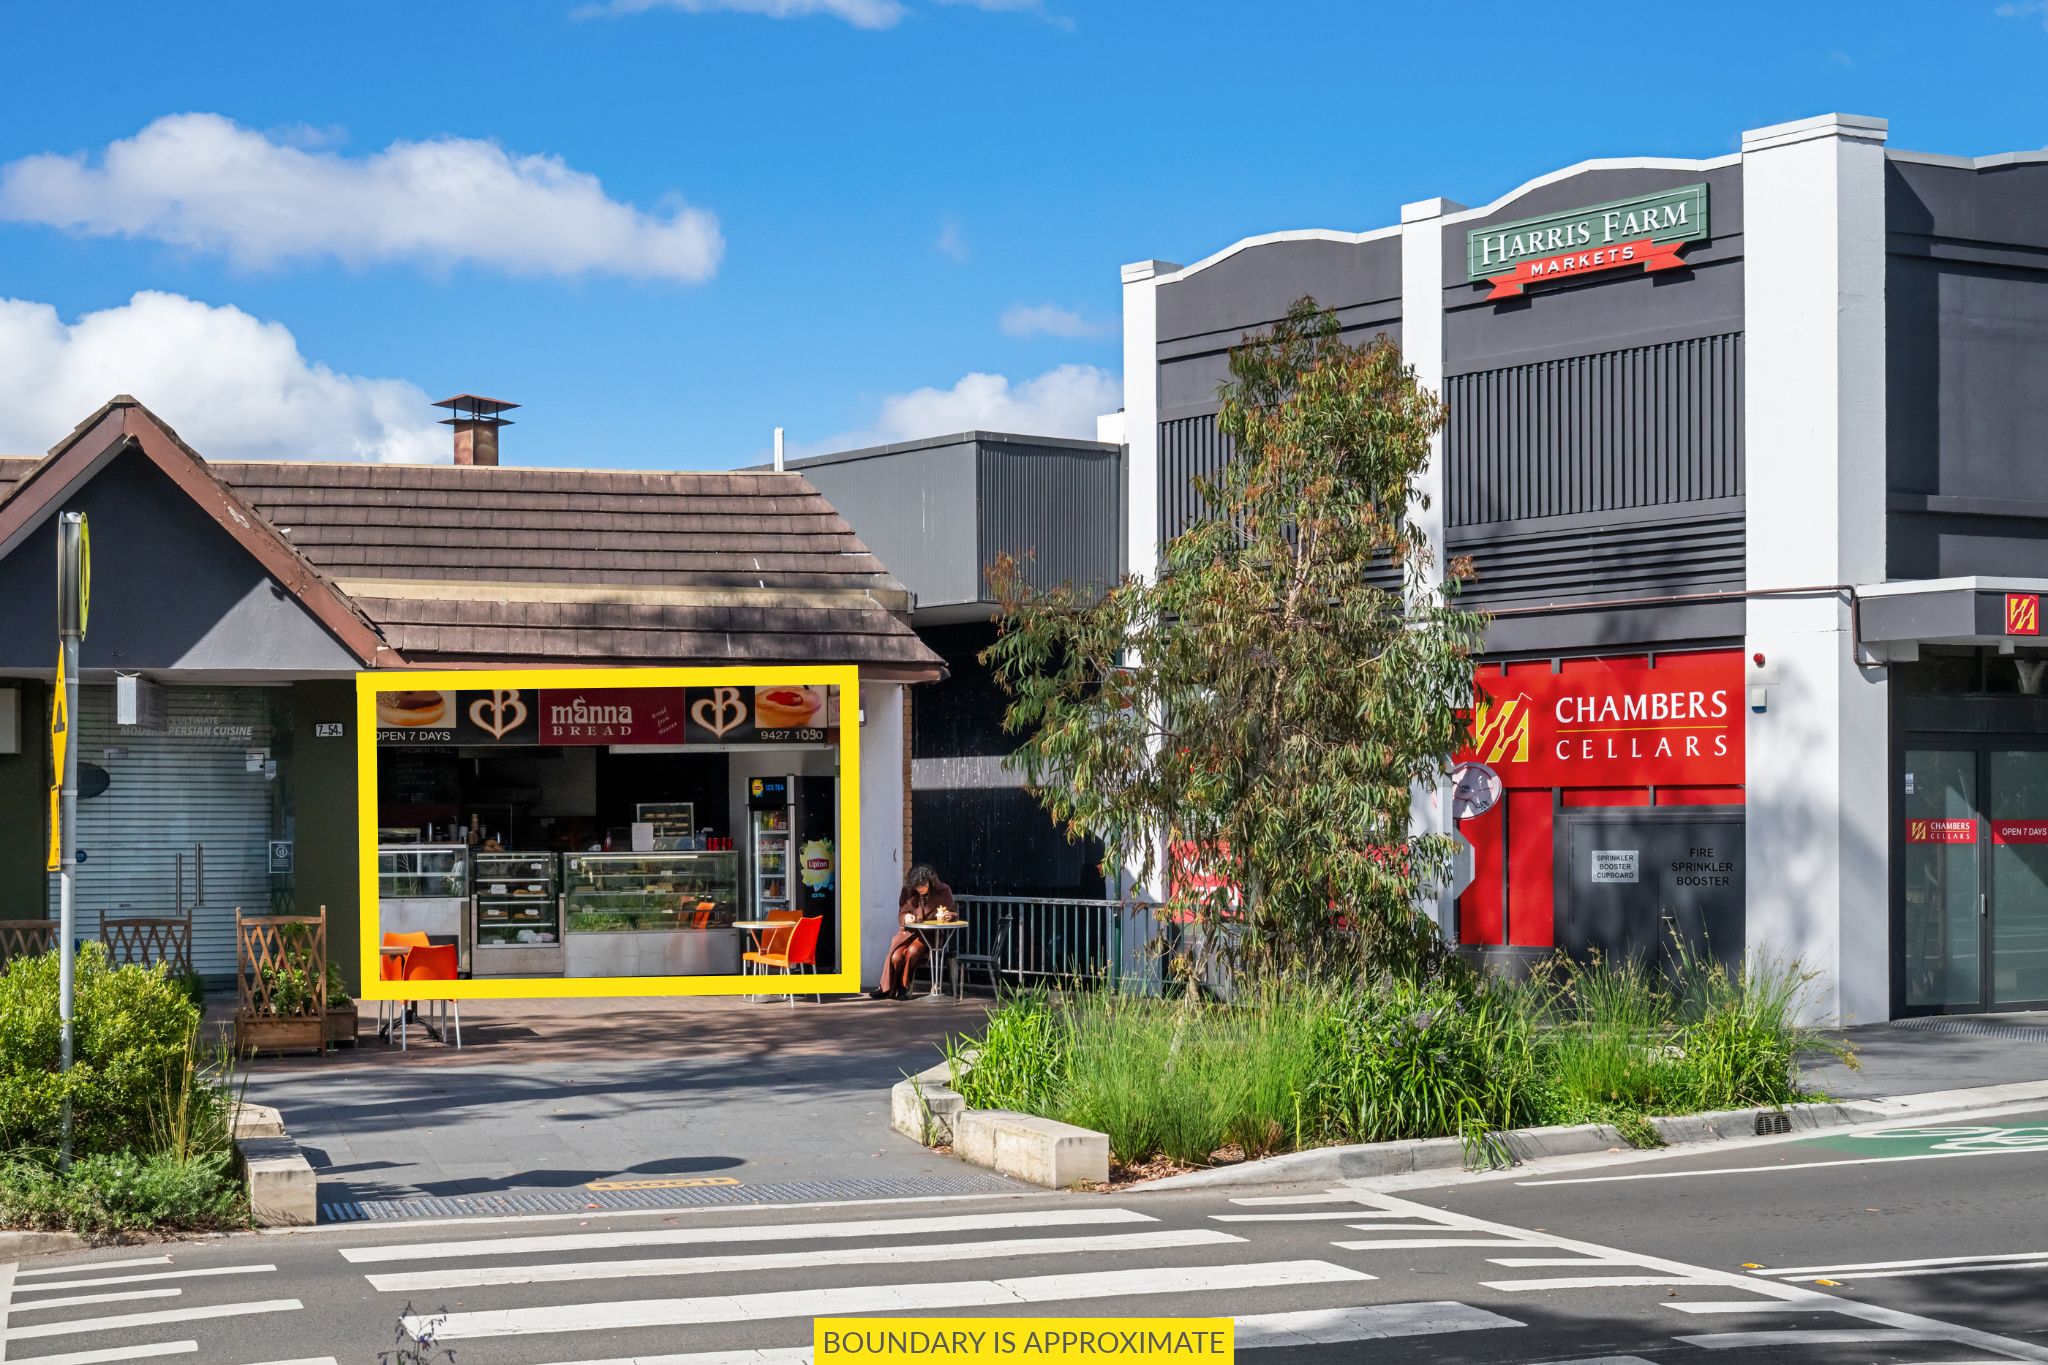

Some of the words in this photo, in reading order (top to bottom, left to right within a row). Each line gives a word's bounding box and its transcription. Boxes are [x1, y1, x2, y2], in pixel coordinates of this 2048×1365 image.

[1481, 221, 1590, 266] HARRIS
[1602, 201, 1689, 243] FARM
[1531, 246, 1635, 277] MARKETS
[1555, 690, 1728, 724] CHAMBERS
[167, 726, 212, 736] PERSIAN
[213, 726, 253, 736] CUISINE
[409, 731, 416, 740] 7
[419, 731, 451, 740] DAYS
[553, 726, 632, 736] BREAD
[760, 730, 790, 740] 9427
[1555, 735, 1728, 760] CELLARS
[1930, 821, 1970, 830] CHAMBERS
[2002, 828, 2022, 836] OPEN
[2023, 828, 2027, 836] 7
[2028, 828, 2047, 836] DAYS
[1596, 854, 1634, 862] SPRINKLER
[1689, 848, 1714, 858] FIRE
[808, 860, 828, 869] Lipton
[1671, 862, 1733, 872] SPRINKLER
[1676, 876, 1730, 886] BOOSTER
